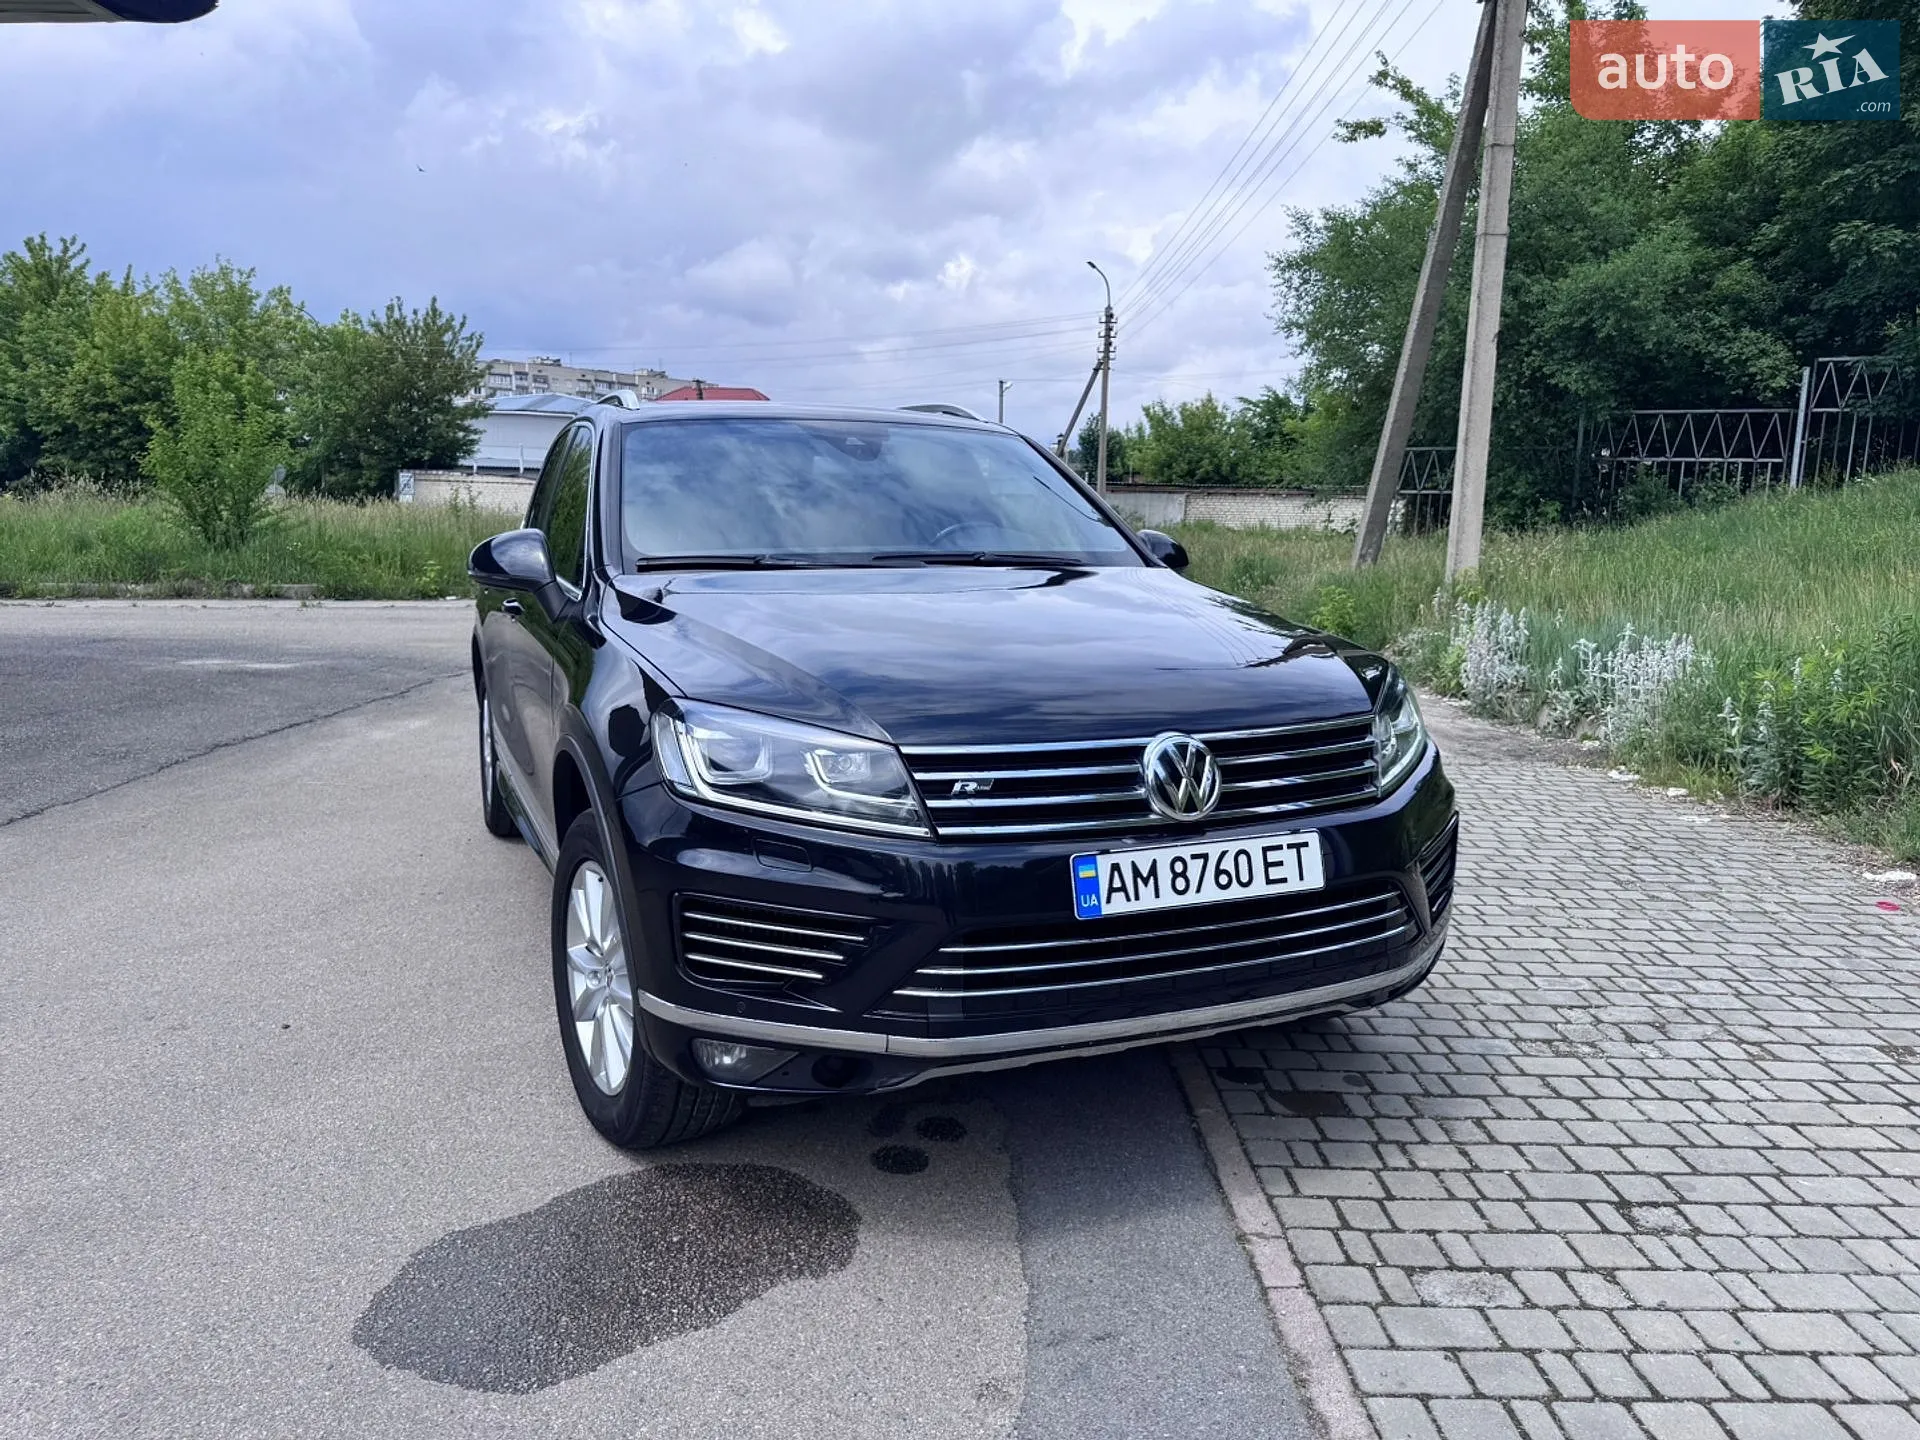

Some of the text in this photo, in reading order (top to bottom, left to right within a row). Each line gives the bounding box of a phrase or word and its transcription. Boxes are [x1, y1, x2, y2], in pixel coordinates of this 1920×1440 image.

[1105, 841, 1310, 904] AM 8760 ET
[1081, 893, 1099, 907] UA
